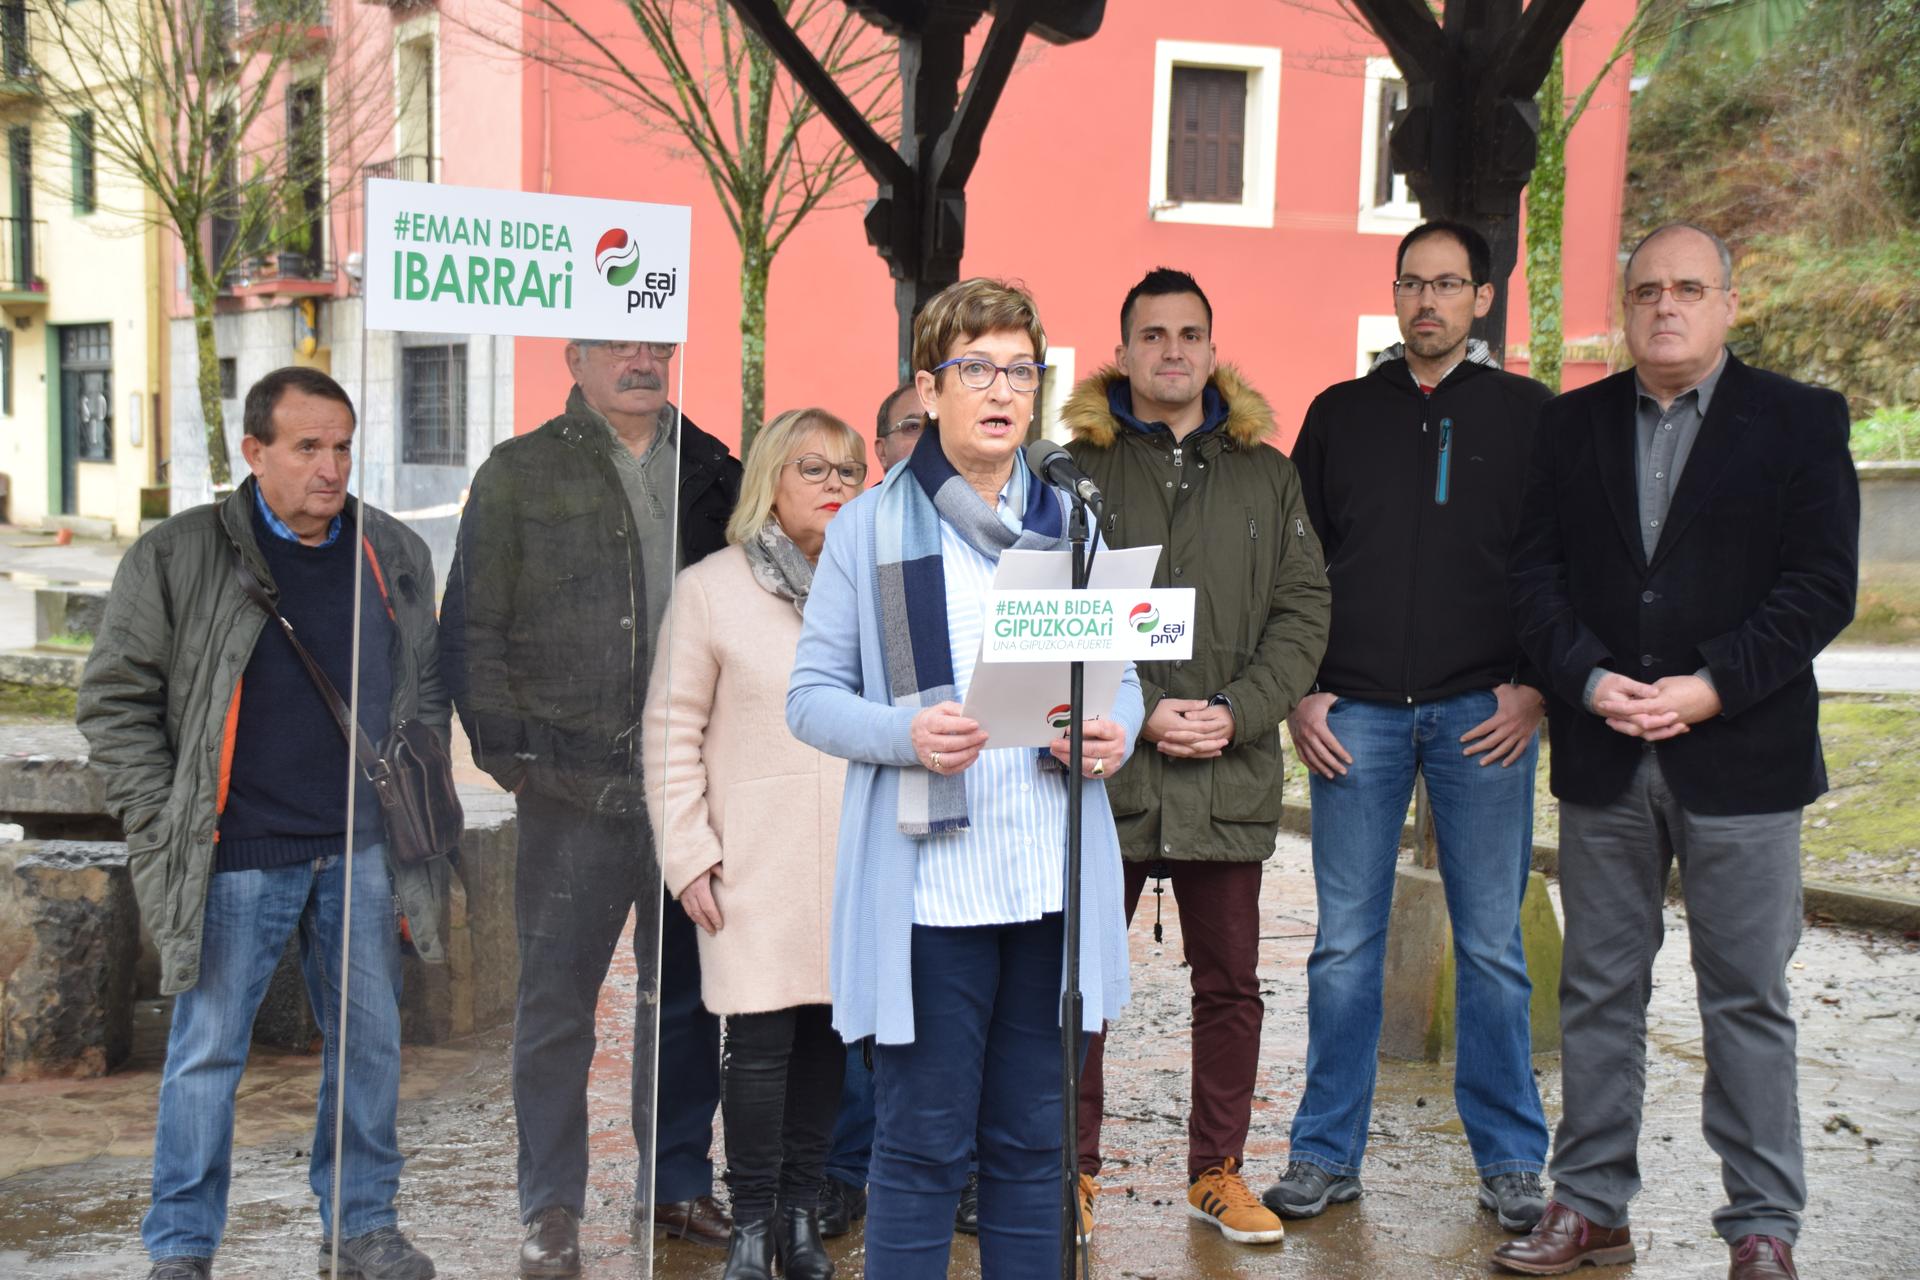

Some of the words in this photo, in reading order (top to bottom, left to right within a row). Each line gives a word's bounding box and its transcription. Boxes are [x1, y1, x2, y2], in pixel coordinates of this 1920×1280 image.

[394, 211, 491, 247] #EMAN
[500, 220, 573, 253] BIDEA
[393, 250, 574, 309] IBARRAri
[645, 267, 677, 296] eaj
[627, 290, 667, 314] pnv
[995, 600, 1058, 616] #EMAN
[1064, 600, 1114, 615] BIDEA
[994, 617, 1114, 638] GIPUZKOAri
[1163, 620, 1186, 636] eaj
[993, 640, 1017, 651] UNA
[1019, 639, 1075, 651] GIPUZKOA
[1077, 638, 1113, 650] FUERTE
[1150, 633, 1178, 648] pnv
